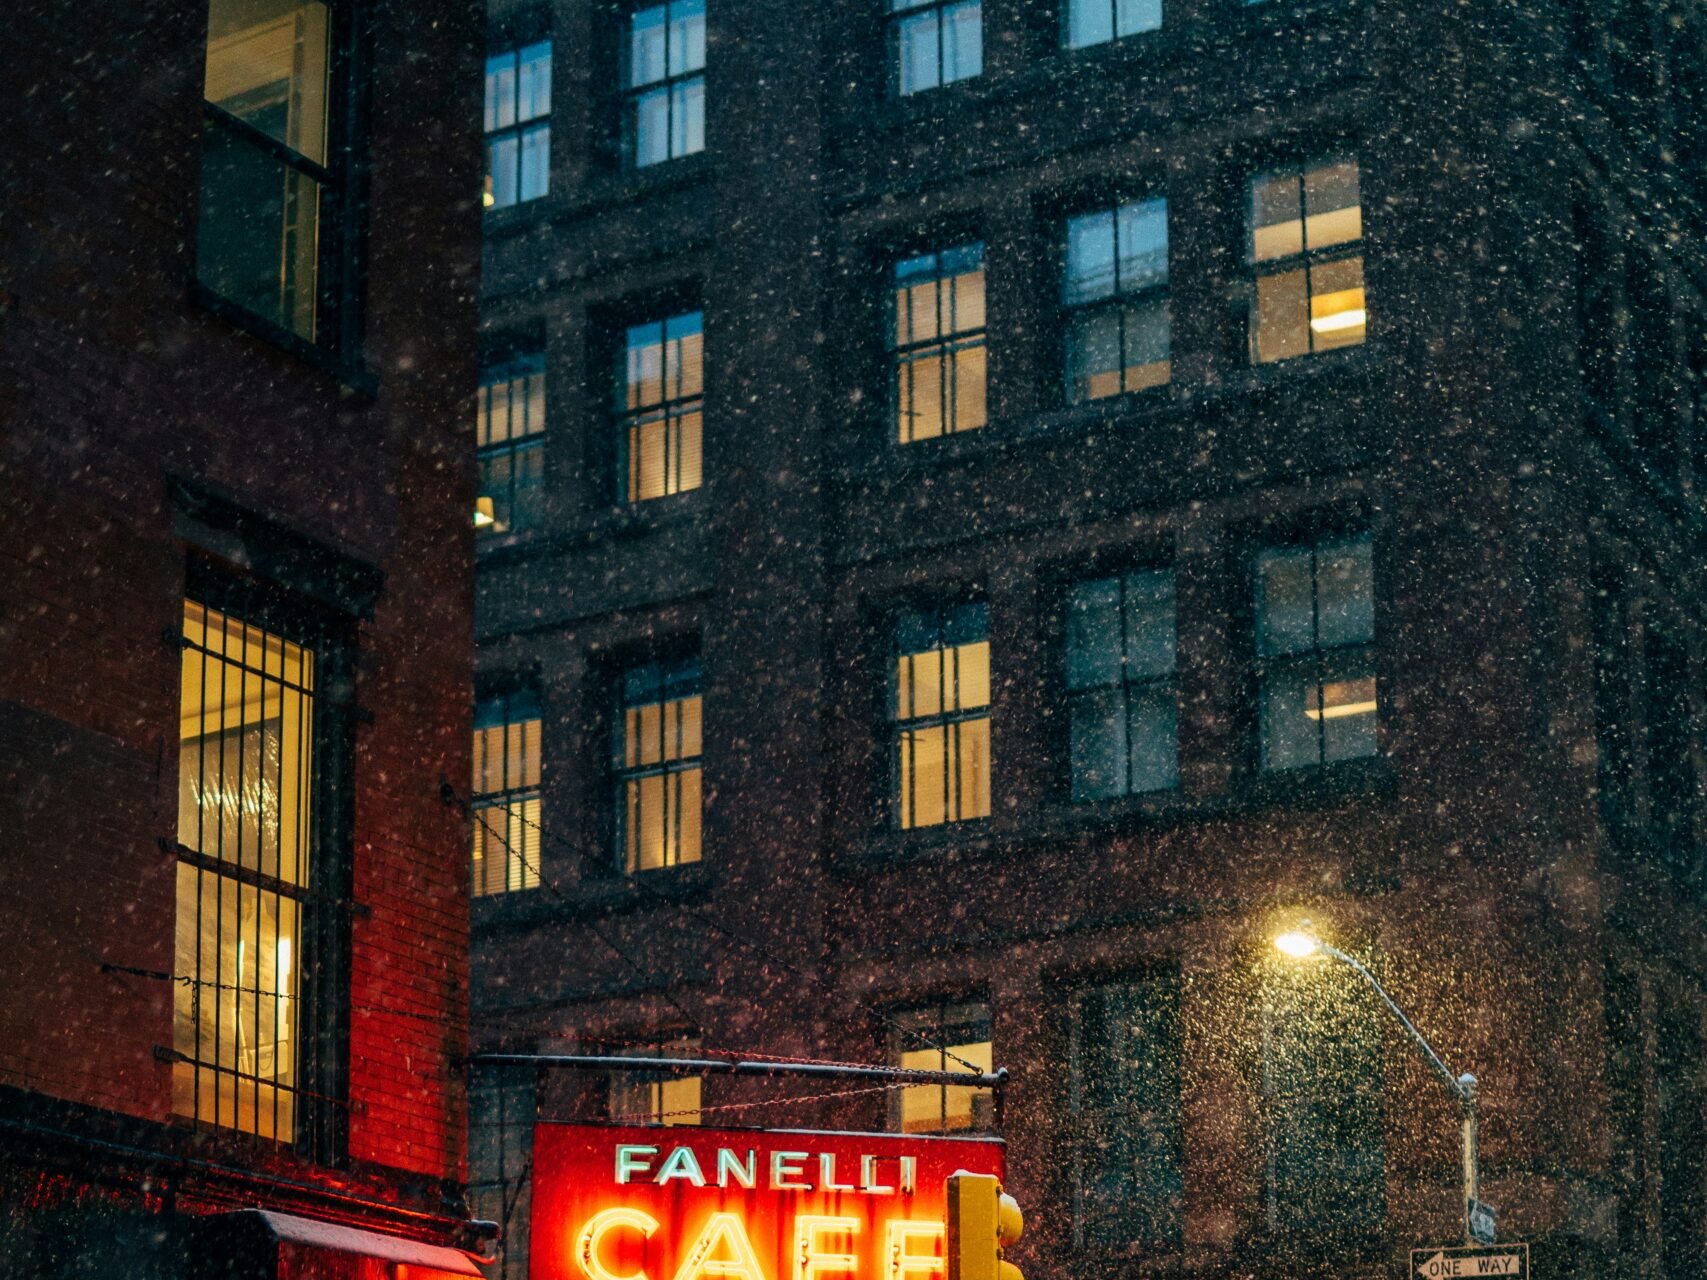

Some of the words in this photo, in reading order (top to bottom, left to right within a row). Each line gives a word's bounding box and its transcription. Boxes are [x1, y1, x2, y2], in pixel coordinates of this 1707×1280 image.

[615, 1143, 917, 1196] FANELLI
[1429, 1261, 1462, 1277] ONE
[1477, 1258, 1512, 1273] WAY
